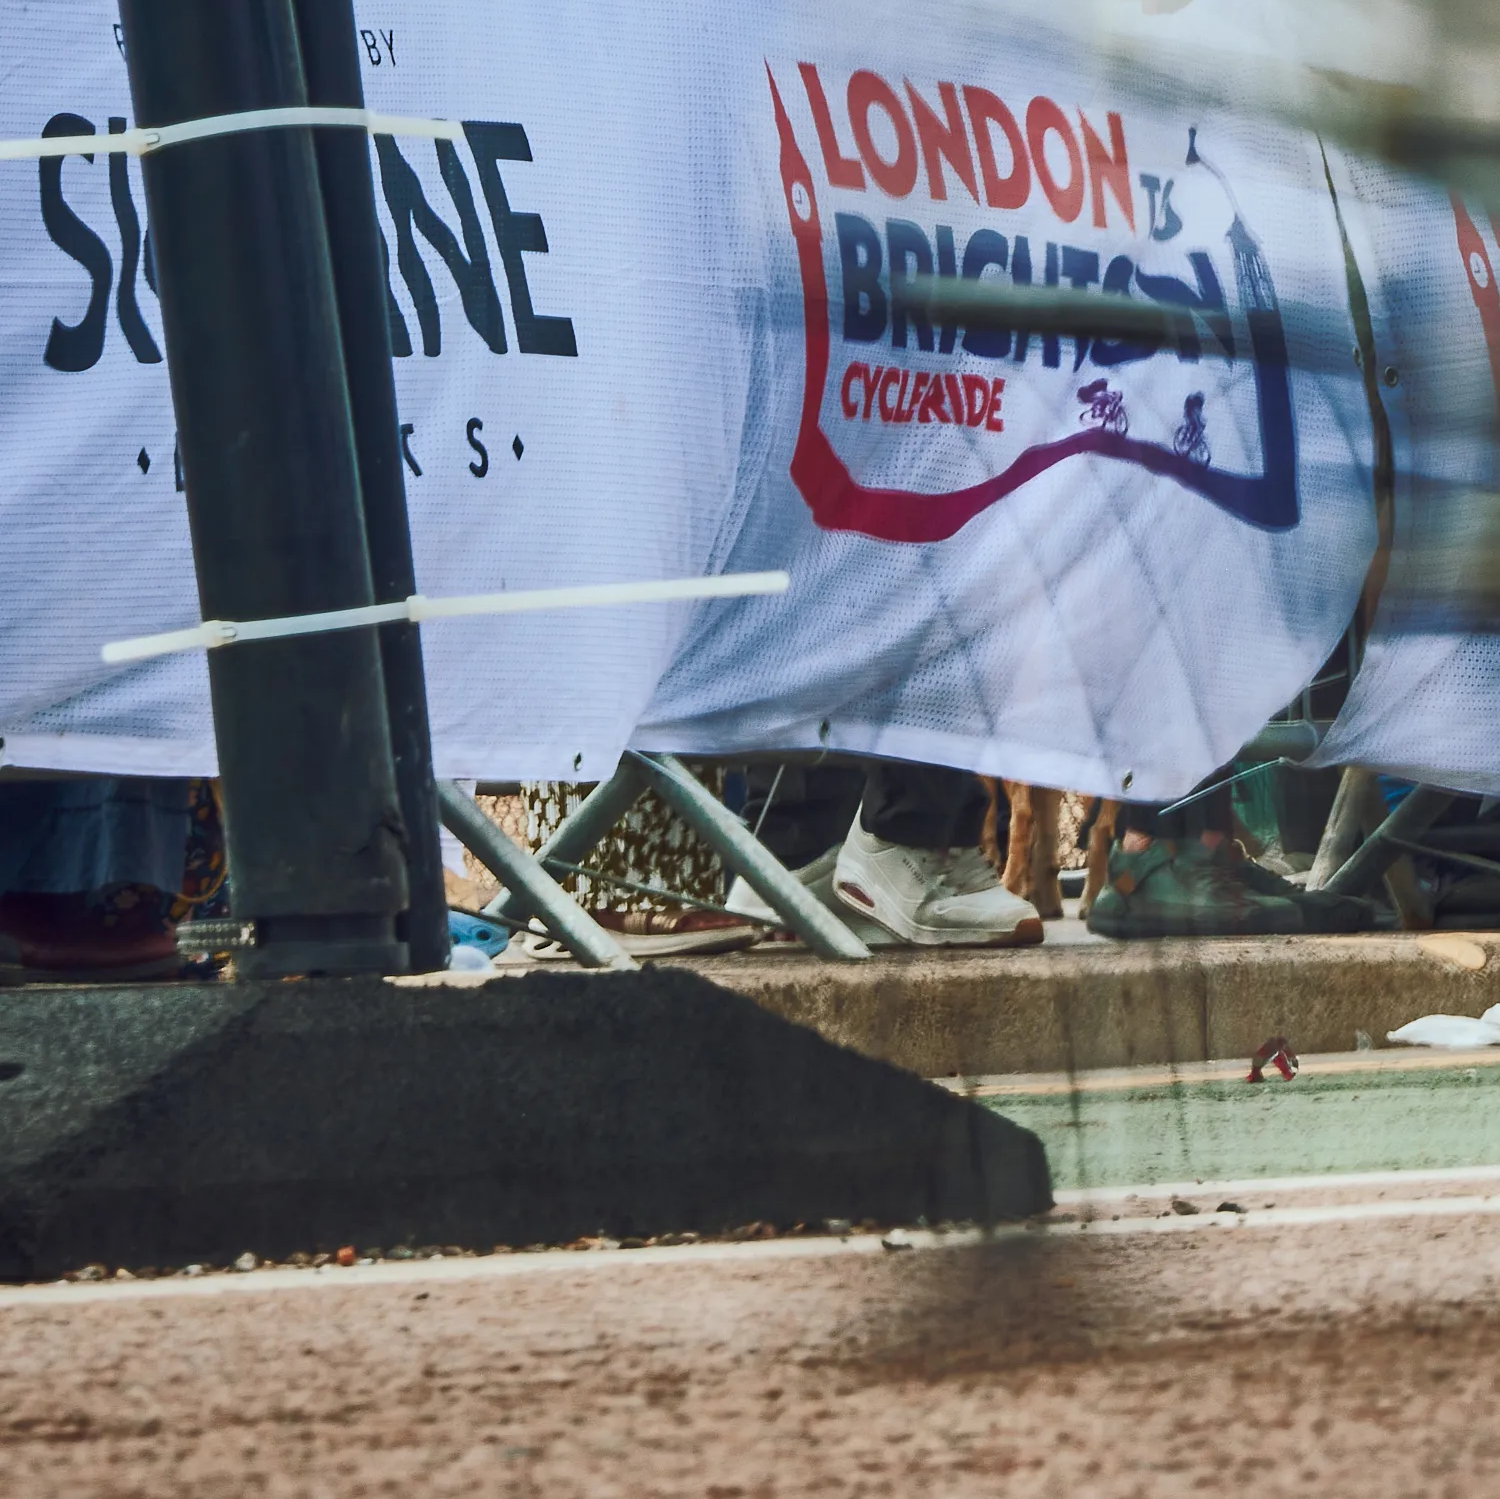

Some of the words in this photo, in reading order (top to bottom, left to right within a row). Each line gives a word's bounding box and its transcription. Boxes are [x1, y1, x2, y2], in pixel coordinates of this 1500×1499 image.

[361, 29, 399, 67] BY
[798, 61, 1136, 233] LONDON
[835, 212, 1236, 375] BRIGHTON
